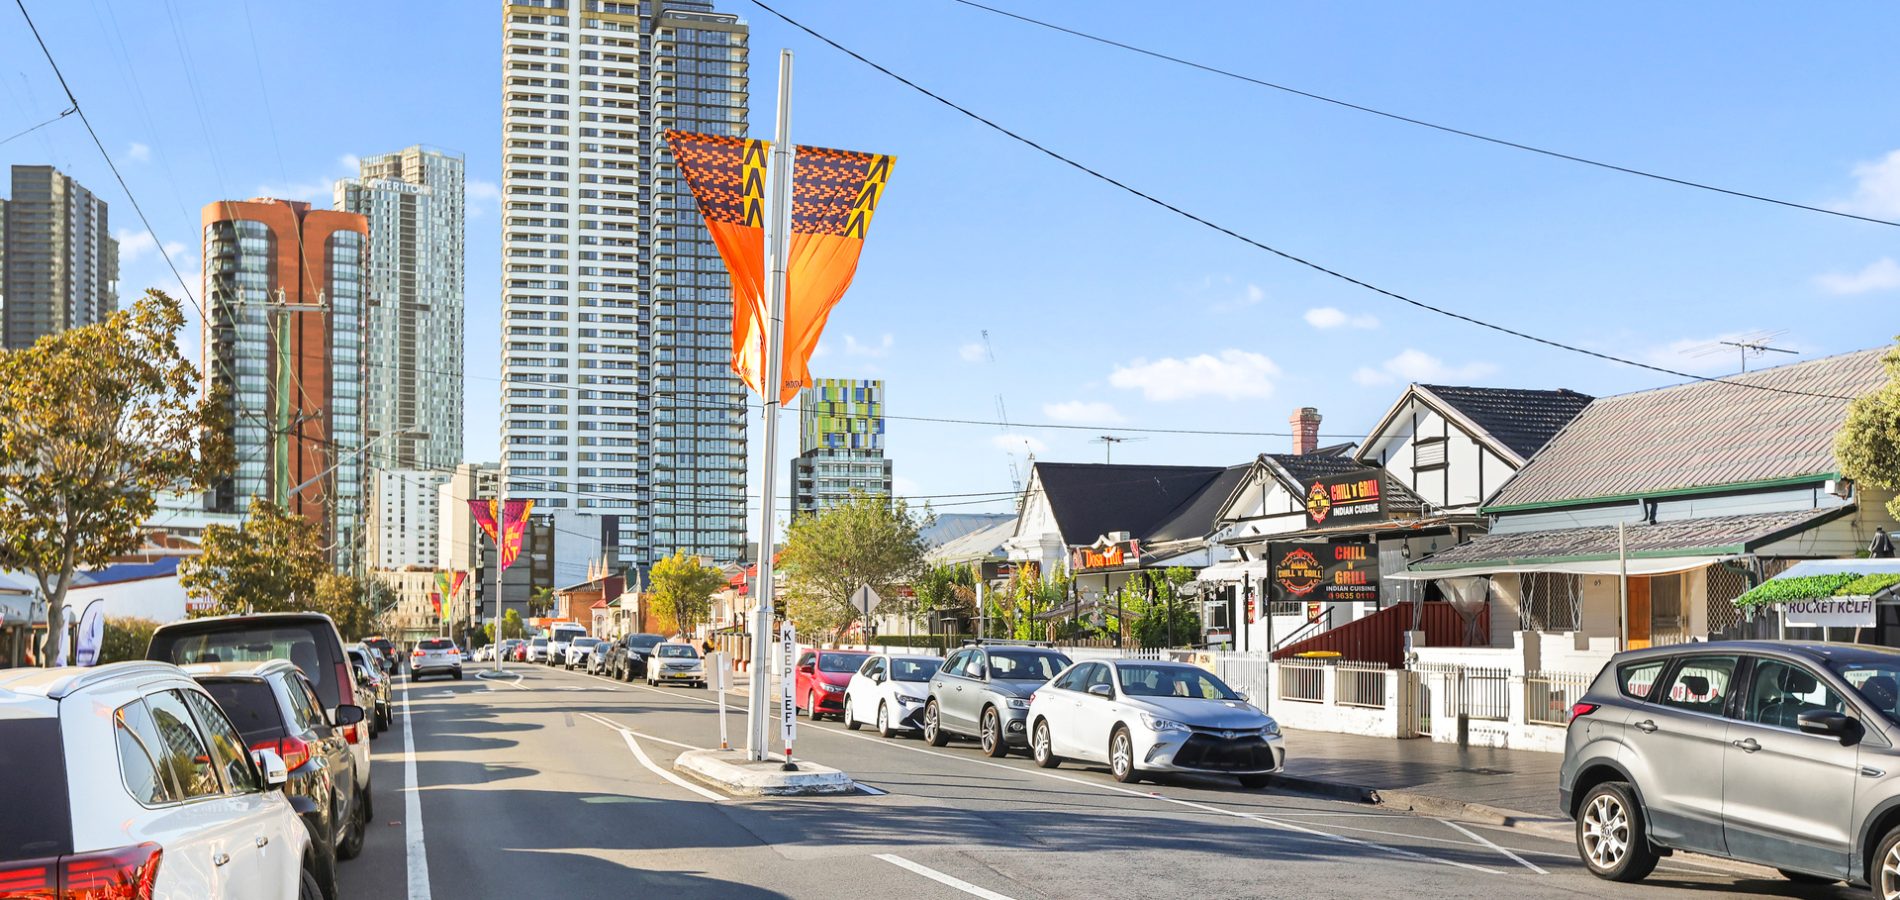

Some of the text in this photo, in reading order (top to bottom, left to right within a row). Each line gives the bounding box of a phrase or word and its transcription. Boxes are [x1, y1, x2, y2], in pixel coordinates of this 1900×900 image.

[1330, 483, 1351, 500] CHILL
[1358, 480, 1379, 497] GRILL
[1333, 503, 1379, 516] INDIAN CUISINE
[1085, 549, 1105, 568] Dosa
[1335, 545, 1367, 560] CHILL
[1335, 571, 1367, 584] GRILL
[1335, 592, 1354, 600] 9635
[1355, 592, 1375, 600] 0110
[784, 630, 792, 736] KEEP LEFT
